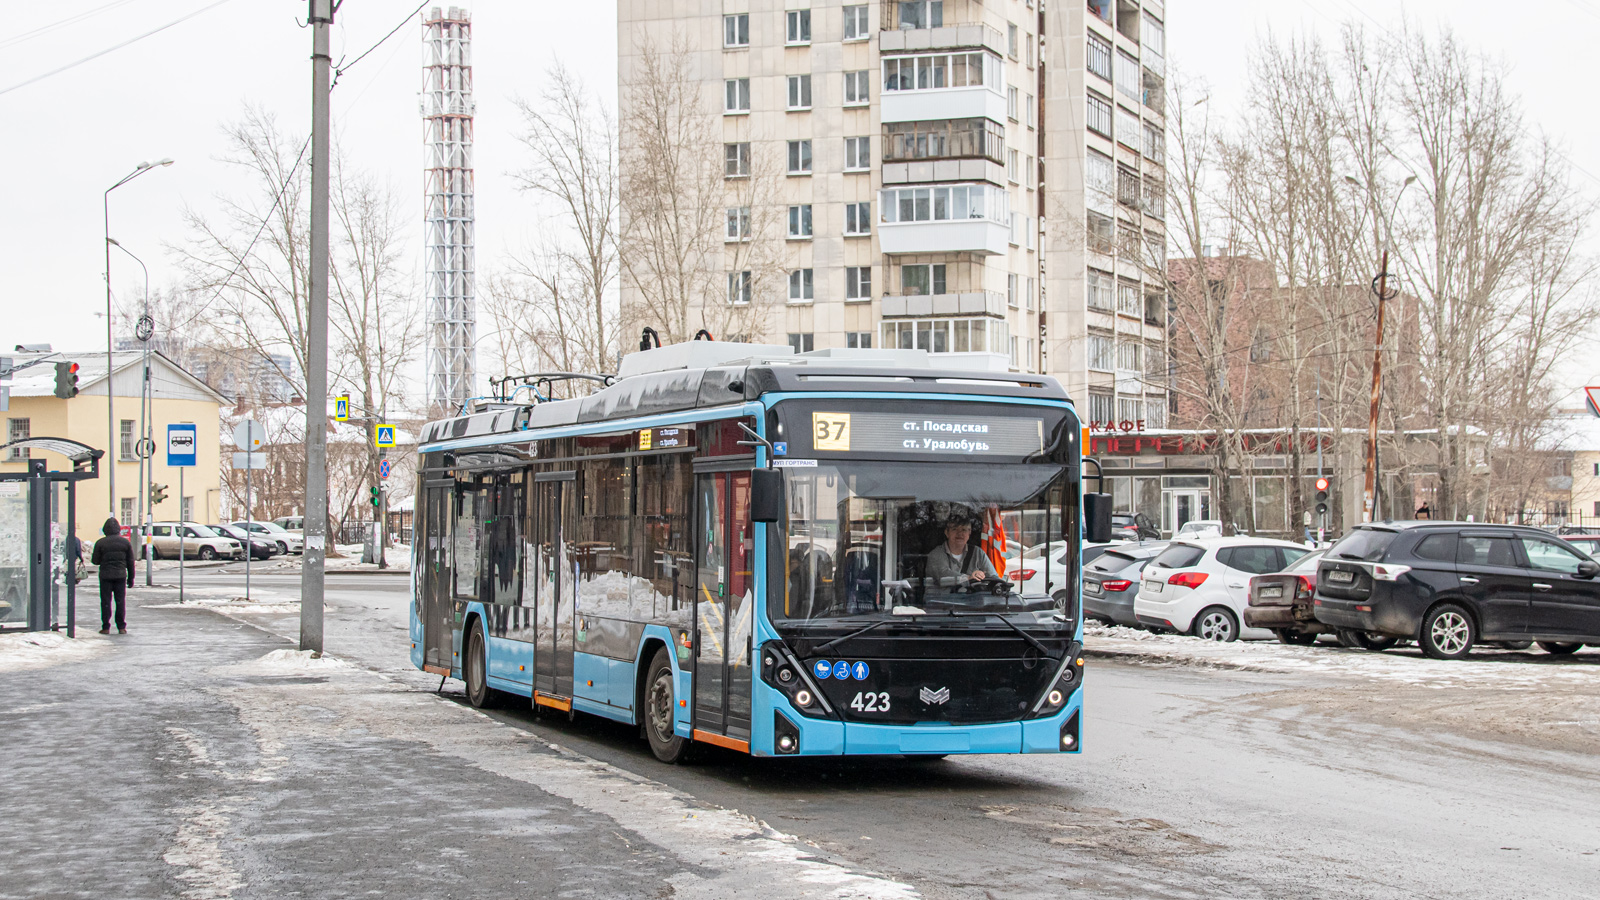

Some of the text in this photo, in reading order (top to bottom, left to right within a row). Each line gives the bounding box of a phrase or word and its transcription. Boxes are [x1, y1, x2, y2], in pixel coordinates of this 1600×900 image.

[817, 420, 846, 440] 37
[903, 421, 988, 433] ст. Посадская
[1090, 419, 1145, 432] КАФЕ
[903, 438, 990, 452] ст. Уралобувь
[850, 691, 891, 712] 423
